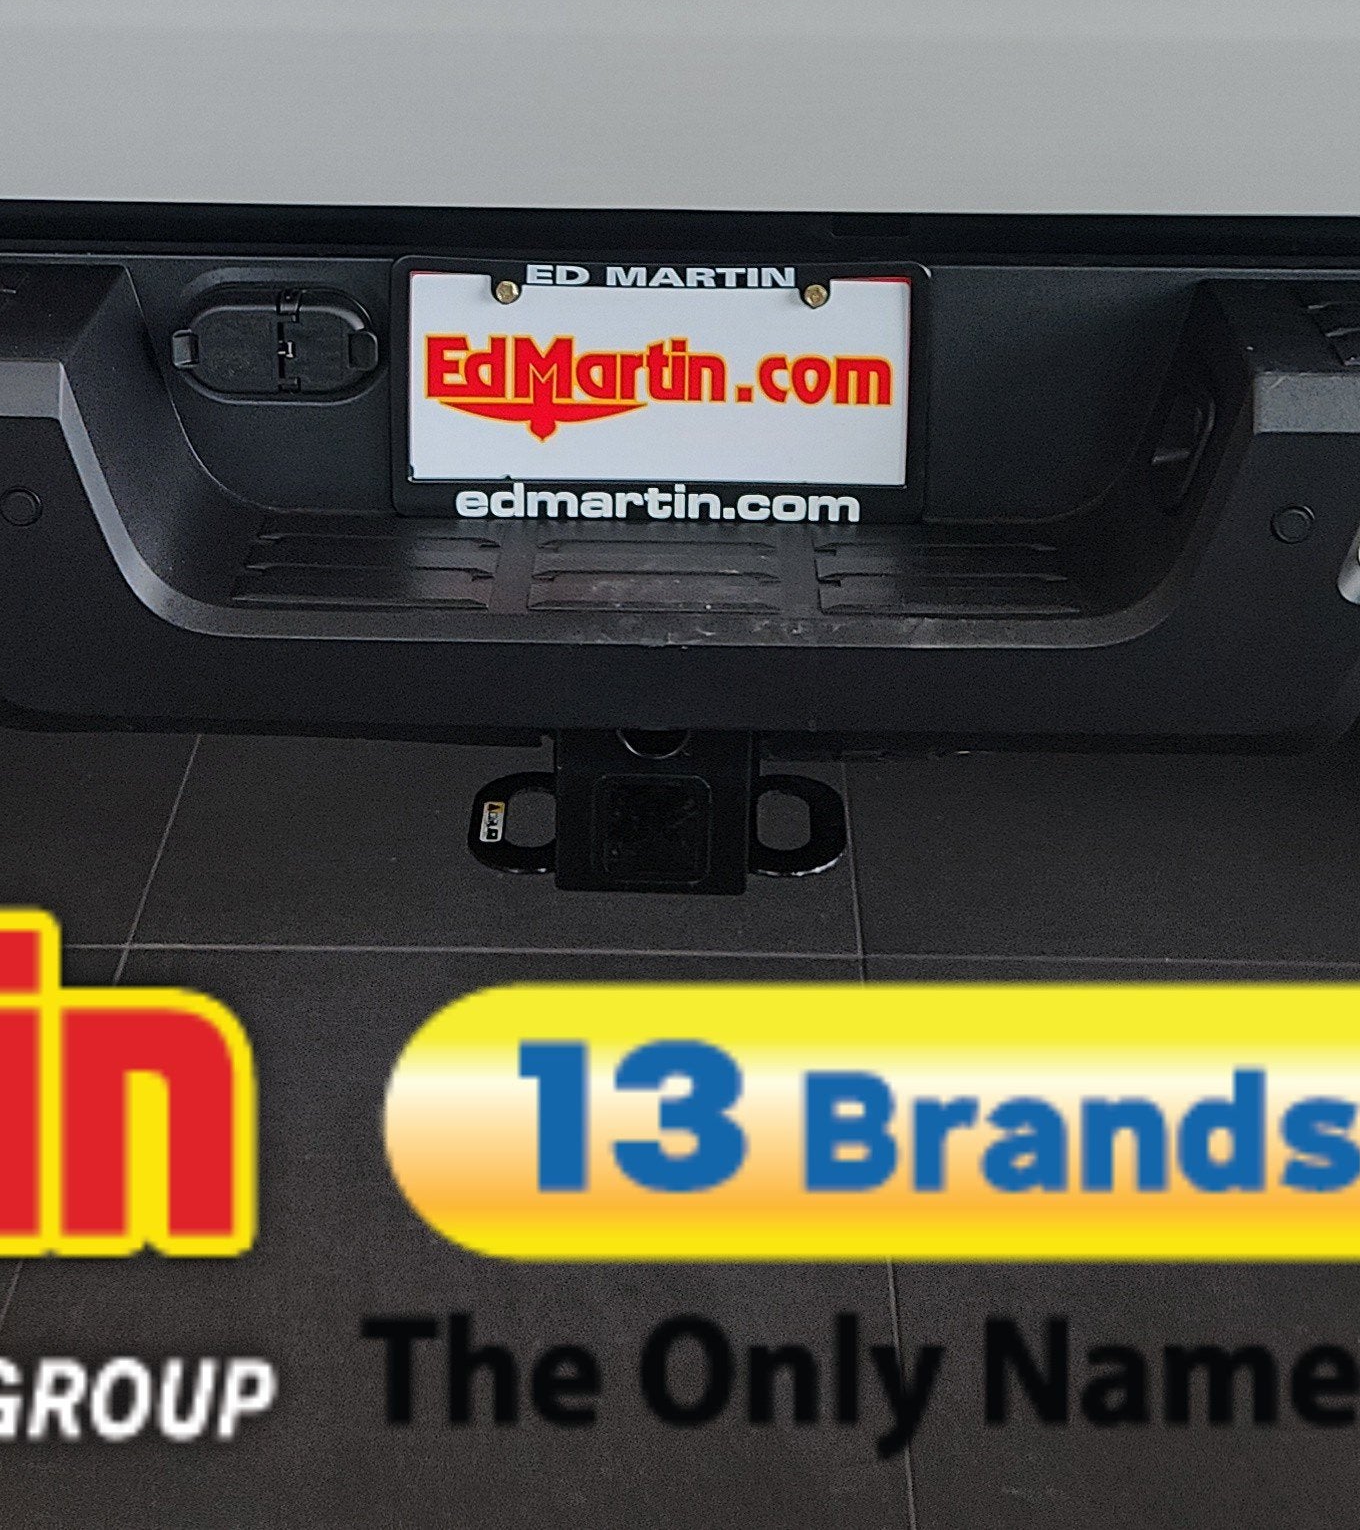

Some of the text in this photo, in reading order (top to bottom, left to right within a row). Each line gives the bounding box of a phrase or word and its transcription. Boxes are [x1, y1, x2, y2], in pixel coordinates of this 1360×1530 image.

[526, 263, 797, 289] ED MARTIN
[455, 482, 862, 524] edmartin.com
